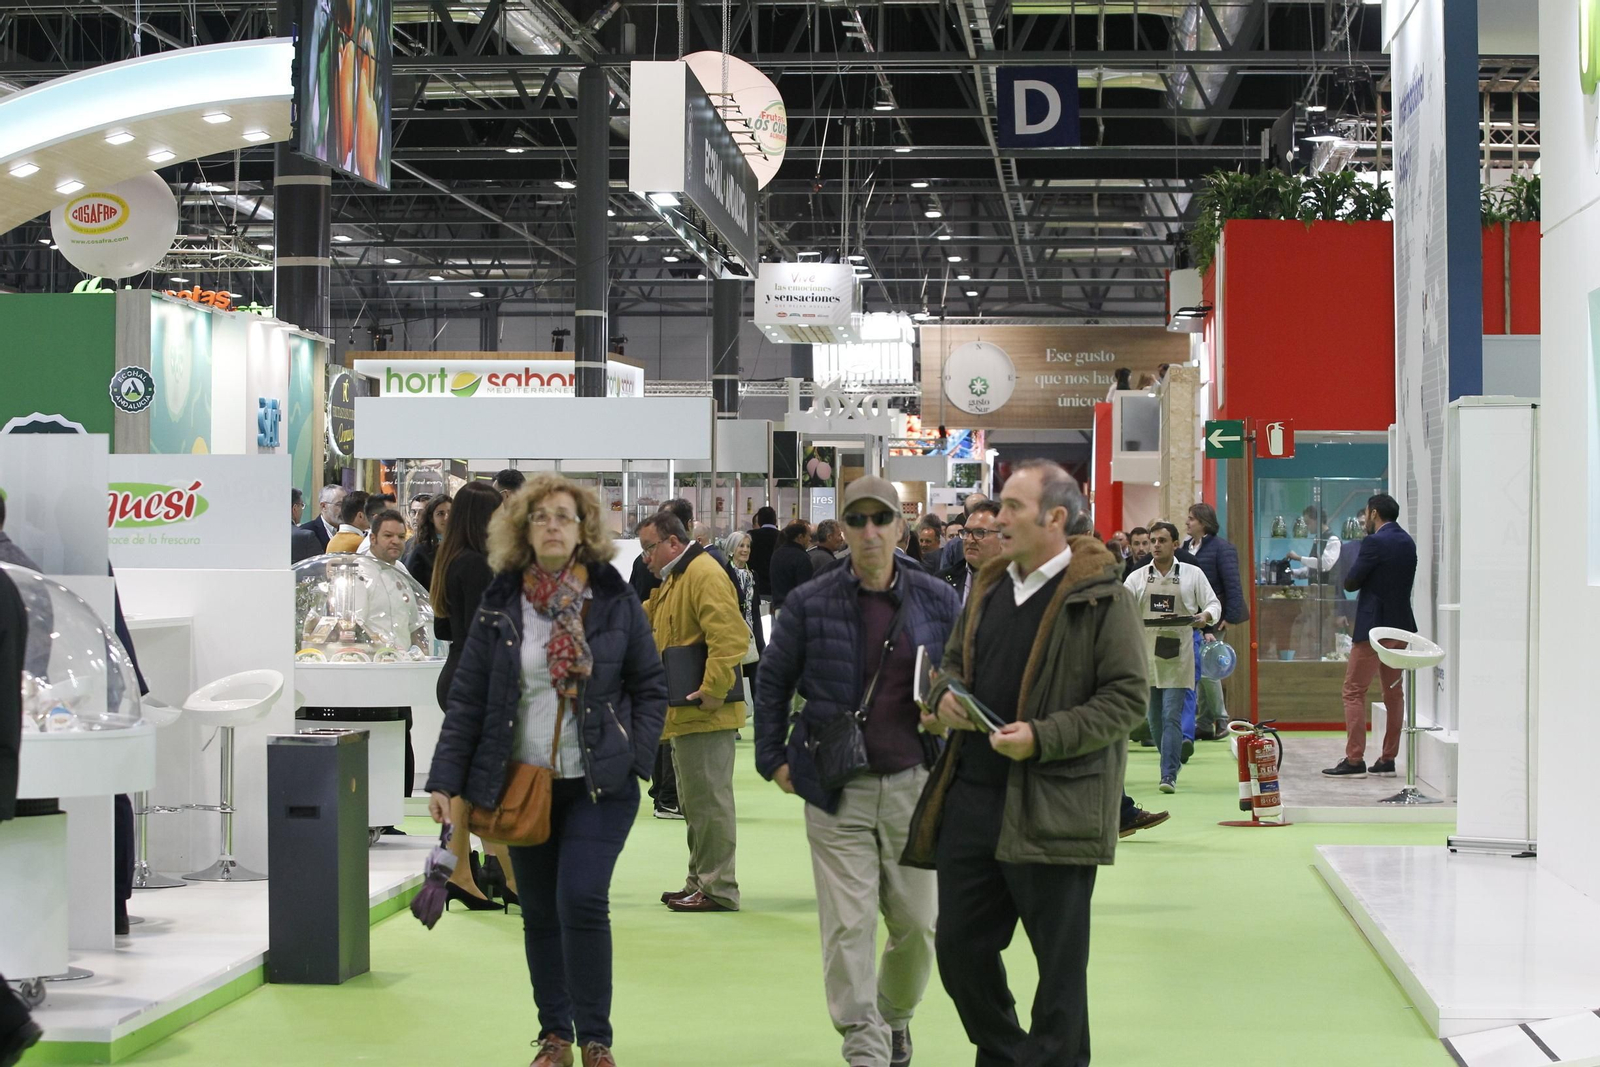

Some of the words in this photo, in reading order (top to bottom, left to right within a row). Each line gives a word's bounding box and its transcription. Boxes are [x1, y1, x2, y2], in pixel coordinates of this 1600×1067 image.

[1013, 79, 1062, 135] D
[747, 117, 770, 131] LOS
[71, 203, 118, 224] COSAFRA
[70, 236, 129, 245] www.cosafra.com
[774, 283, 787, 291] las
[764, 294, 774, 304] y
[774, 292, 841, 303] sensaciones
[1046, 348, 1072, 362] Ese
[1074, 350, 1115, 366] gusto
[117, 370, 148, 383] ECOHAL
[1035, 373, 1062, 389] que
[1065, 374, 1090, 385] nos
[1093, 371, 1117, 384] hac
[114, 395, 151, 409] ANDALUCIA
[132, 533, 145, 545] de
[148, 533, 157, 545] la
[160, 533, 201, 545] frescura
